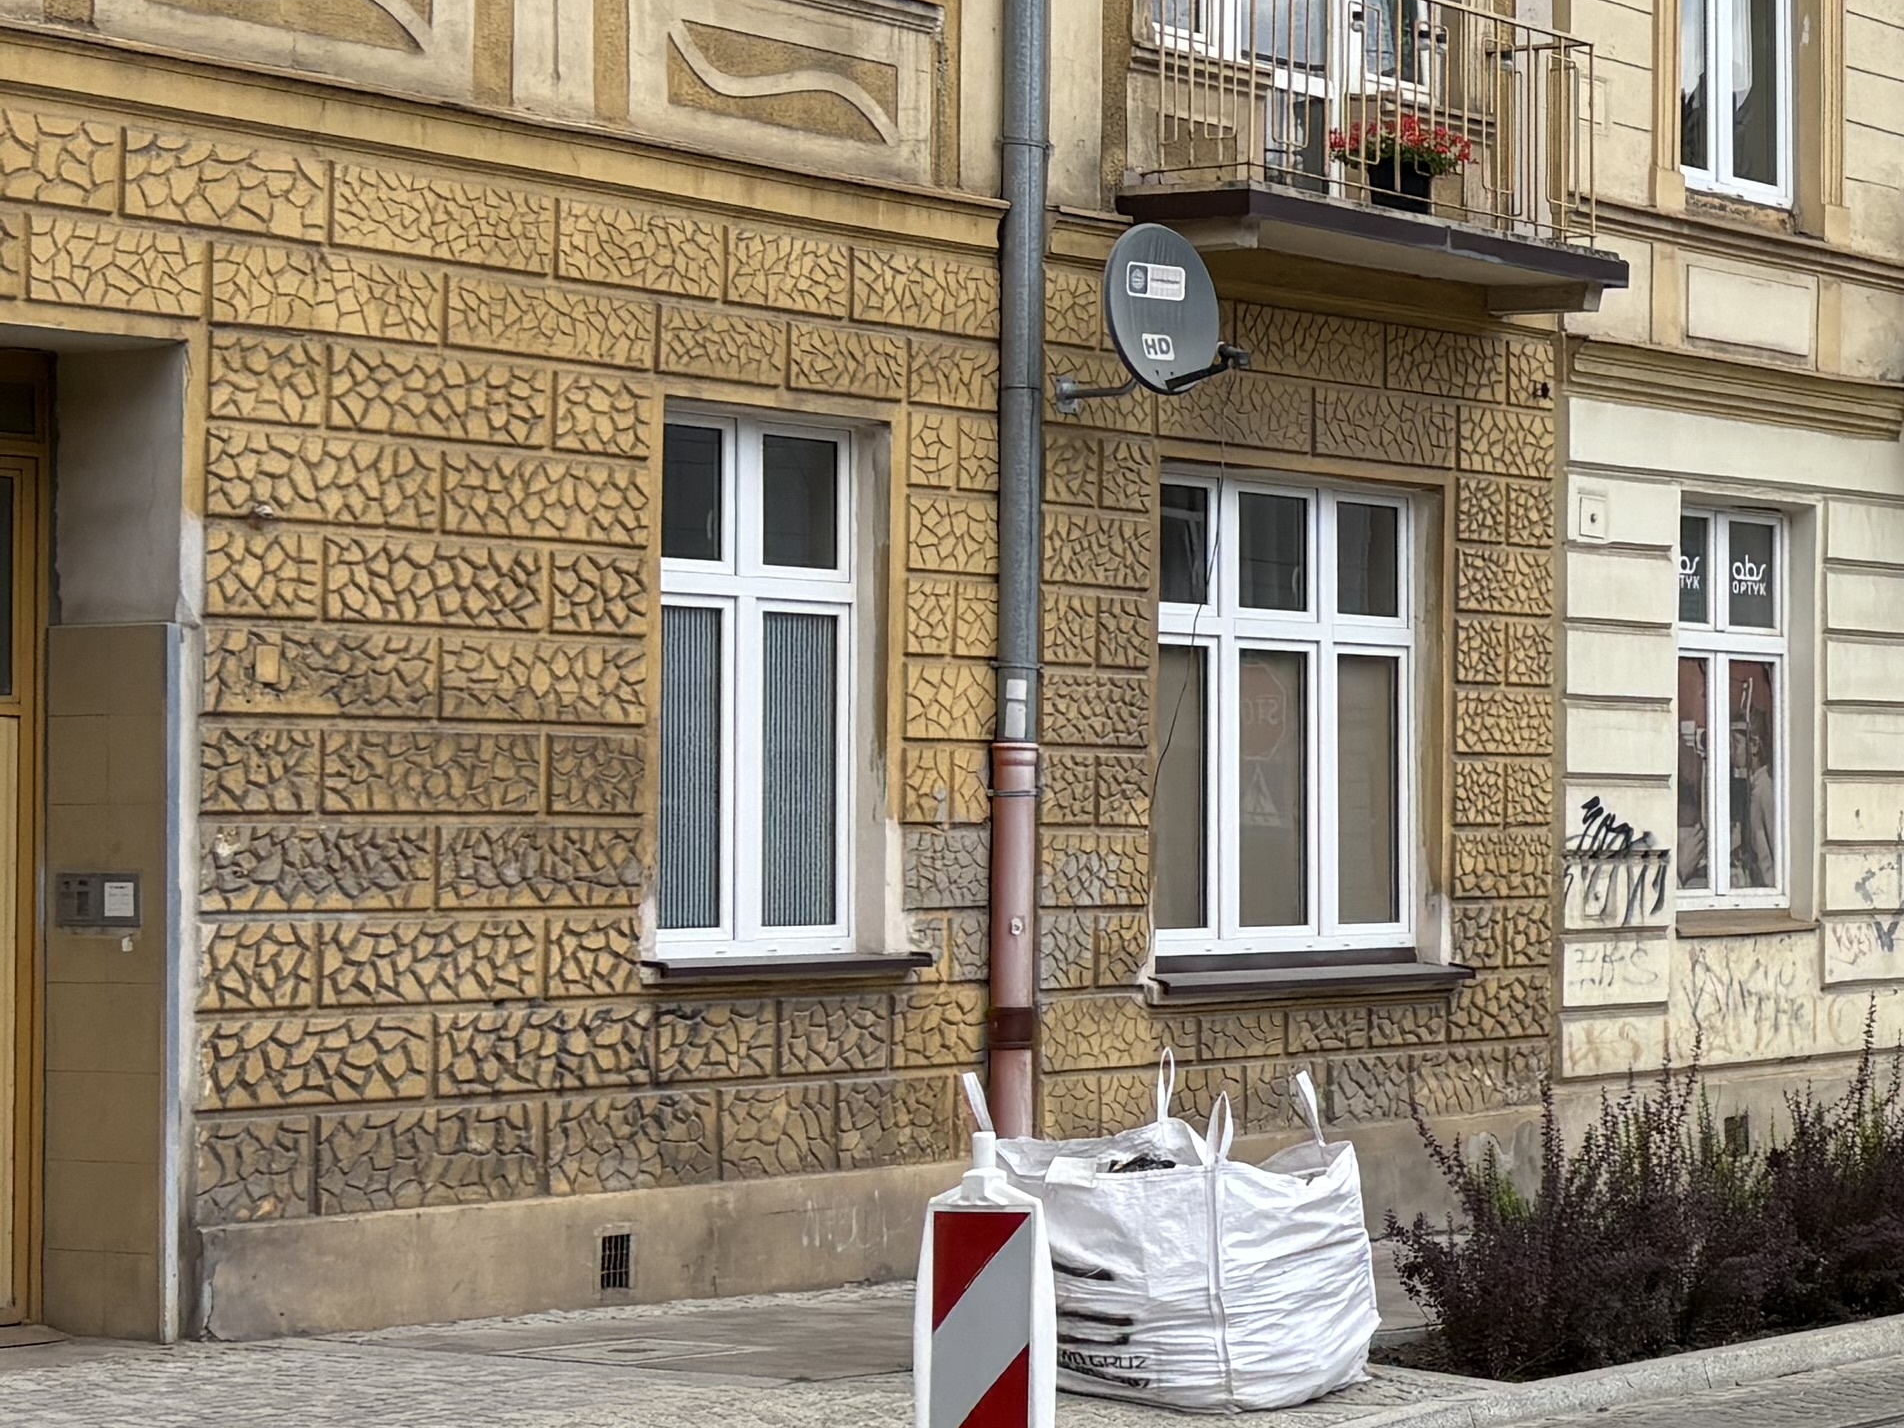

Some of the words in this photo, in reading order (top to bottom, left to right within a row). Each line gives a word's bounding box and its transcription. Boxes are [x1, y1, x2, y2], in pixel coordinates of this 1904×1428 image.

[1145, 338, 1170, 355] HD
[1733, 554, 1767, 581] abs
[1732, 581, 1767, 597] OPTYK
[1088, 1355, 1149, 1370] GRUZ
